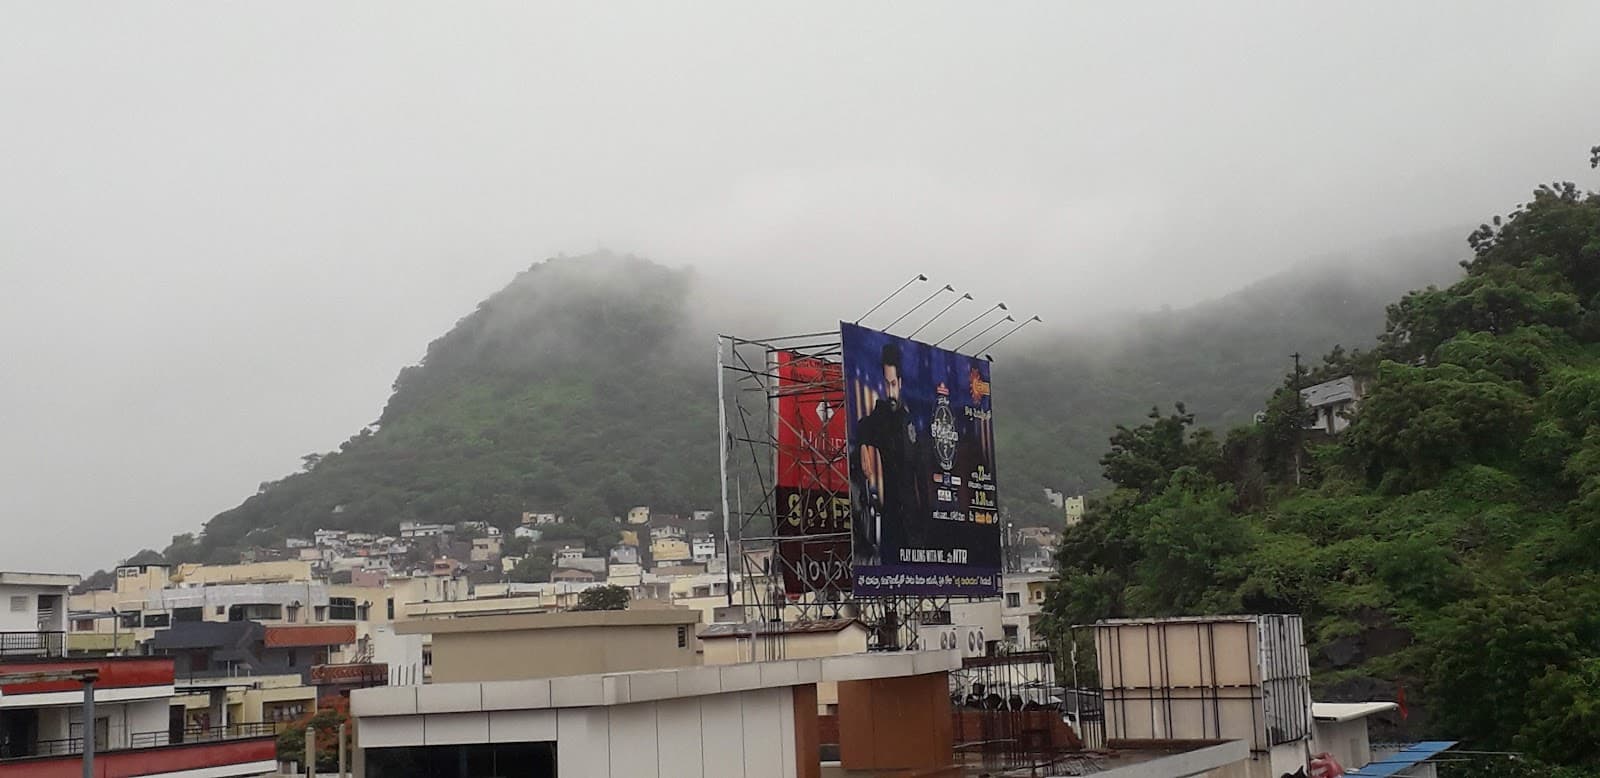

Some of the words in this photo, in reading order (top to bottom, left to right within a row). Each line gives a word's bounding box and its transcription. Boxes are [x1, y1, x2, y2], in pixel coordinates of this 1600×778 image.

[899, 548, 911, 562] PLAY
[911, 549, 926, 562] ALONG
[953, 549, 968, 564] NTR
